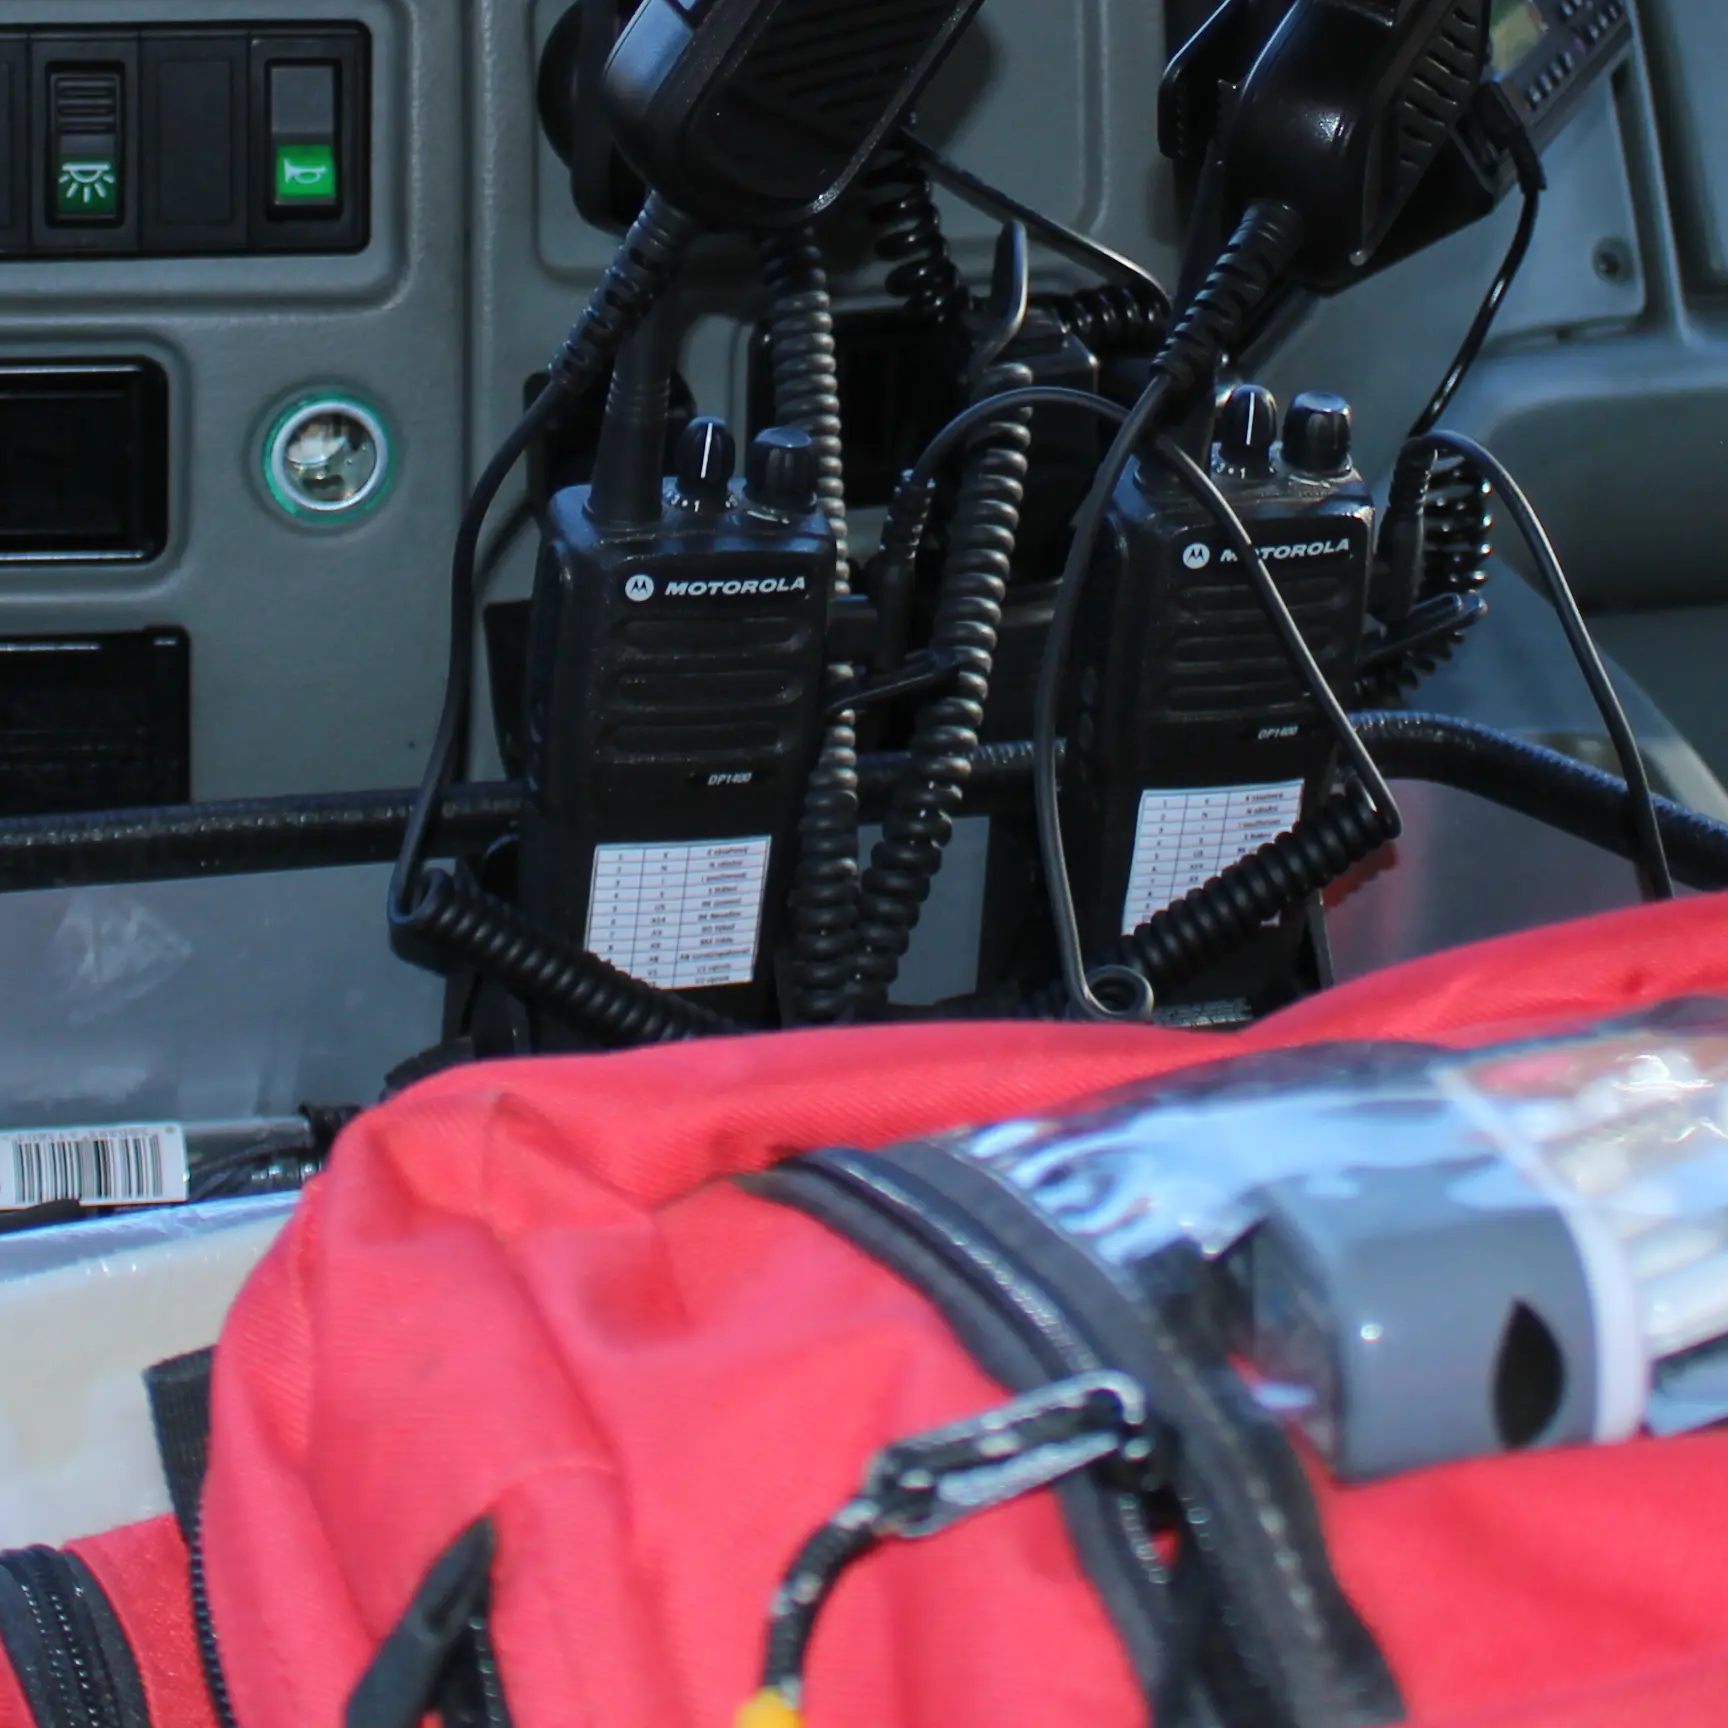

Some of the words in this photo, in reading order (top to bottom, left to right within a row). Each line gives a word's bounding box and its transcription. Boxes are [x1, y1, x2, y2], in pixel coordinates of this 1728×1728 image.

[1219, 537, 1350, 563] MTOROLA
[664, 575, 806, 597] MOTOROLA
[706, 771, 753, 786] DP1400
